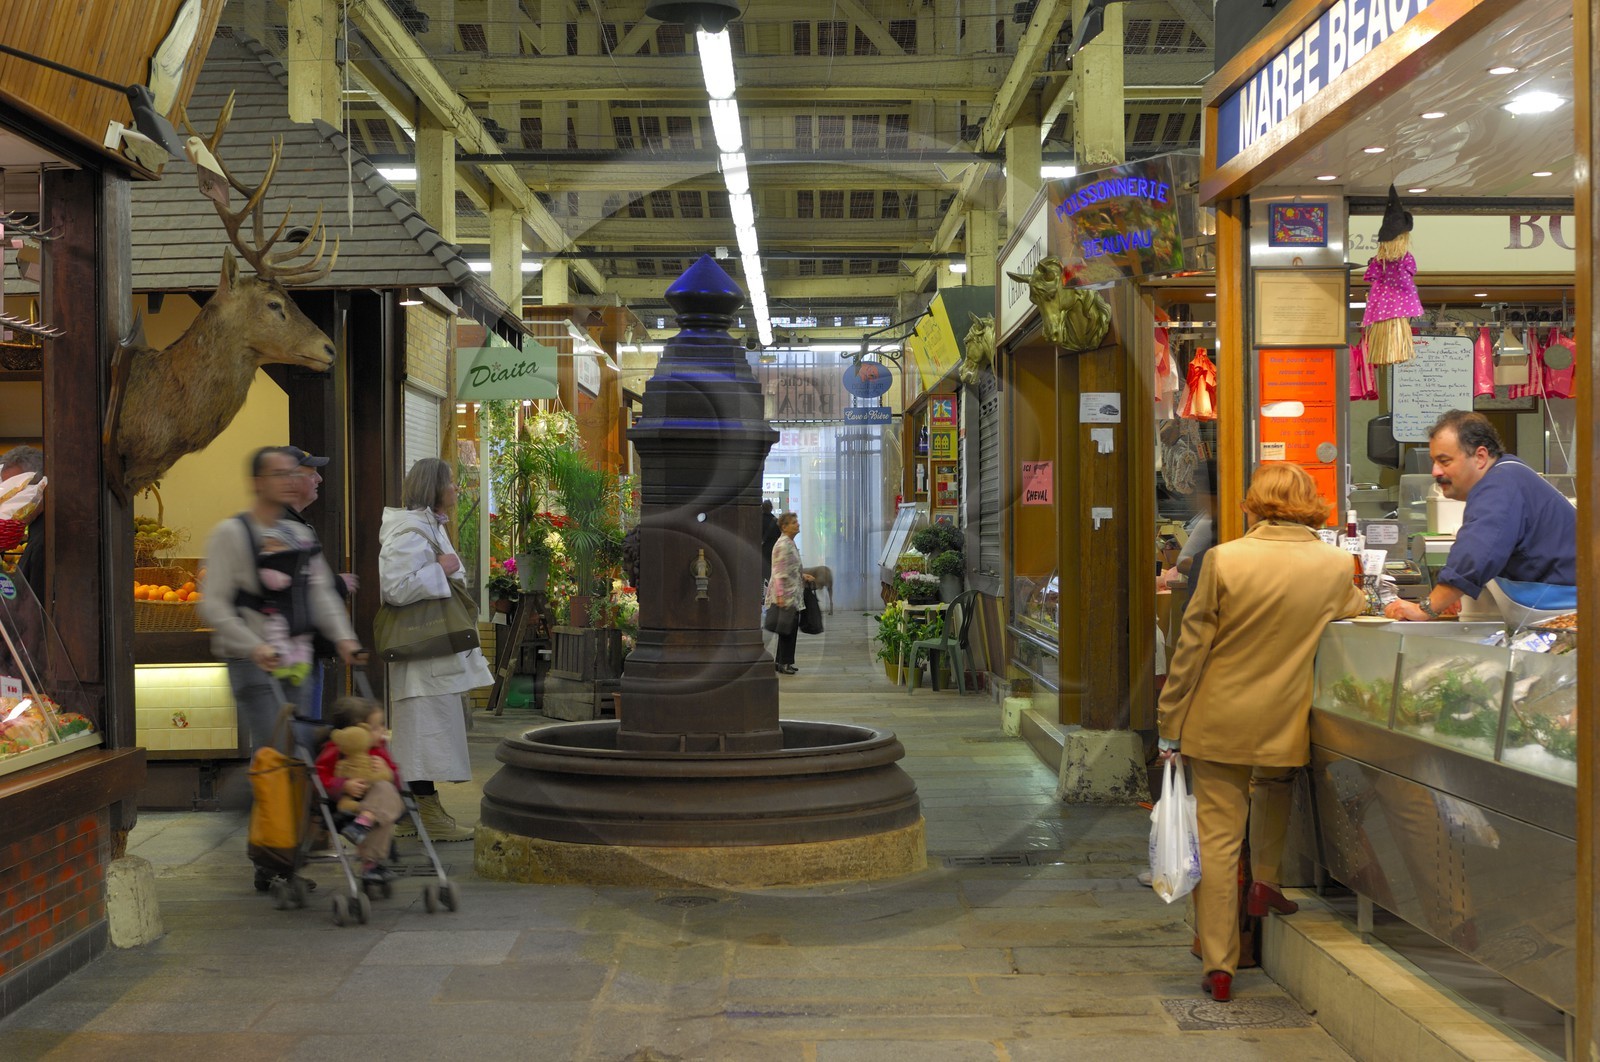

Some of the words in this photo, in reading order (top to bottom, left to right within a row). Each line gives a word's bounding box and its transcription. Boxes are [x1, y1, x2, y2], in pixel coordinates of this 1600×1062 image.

[1239, 20, 1320, 154] MAREE
[1328, 0, 1427, 84] BEA
[1055, 177, 1170, 223] POISSONNERIE
[1082, 229, 1151, 259] BEAUVAU
[470, 361, 539, 388] Diaita
[845, 410, 863, 420] Cave
[869, 409, 889, 421] Bière
[1023, 464, 1031, 472] ICI
[1026, 489, 1048, 502] CHEVAL
